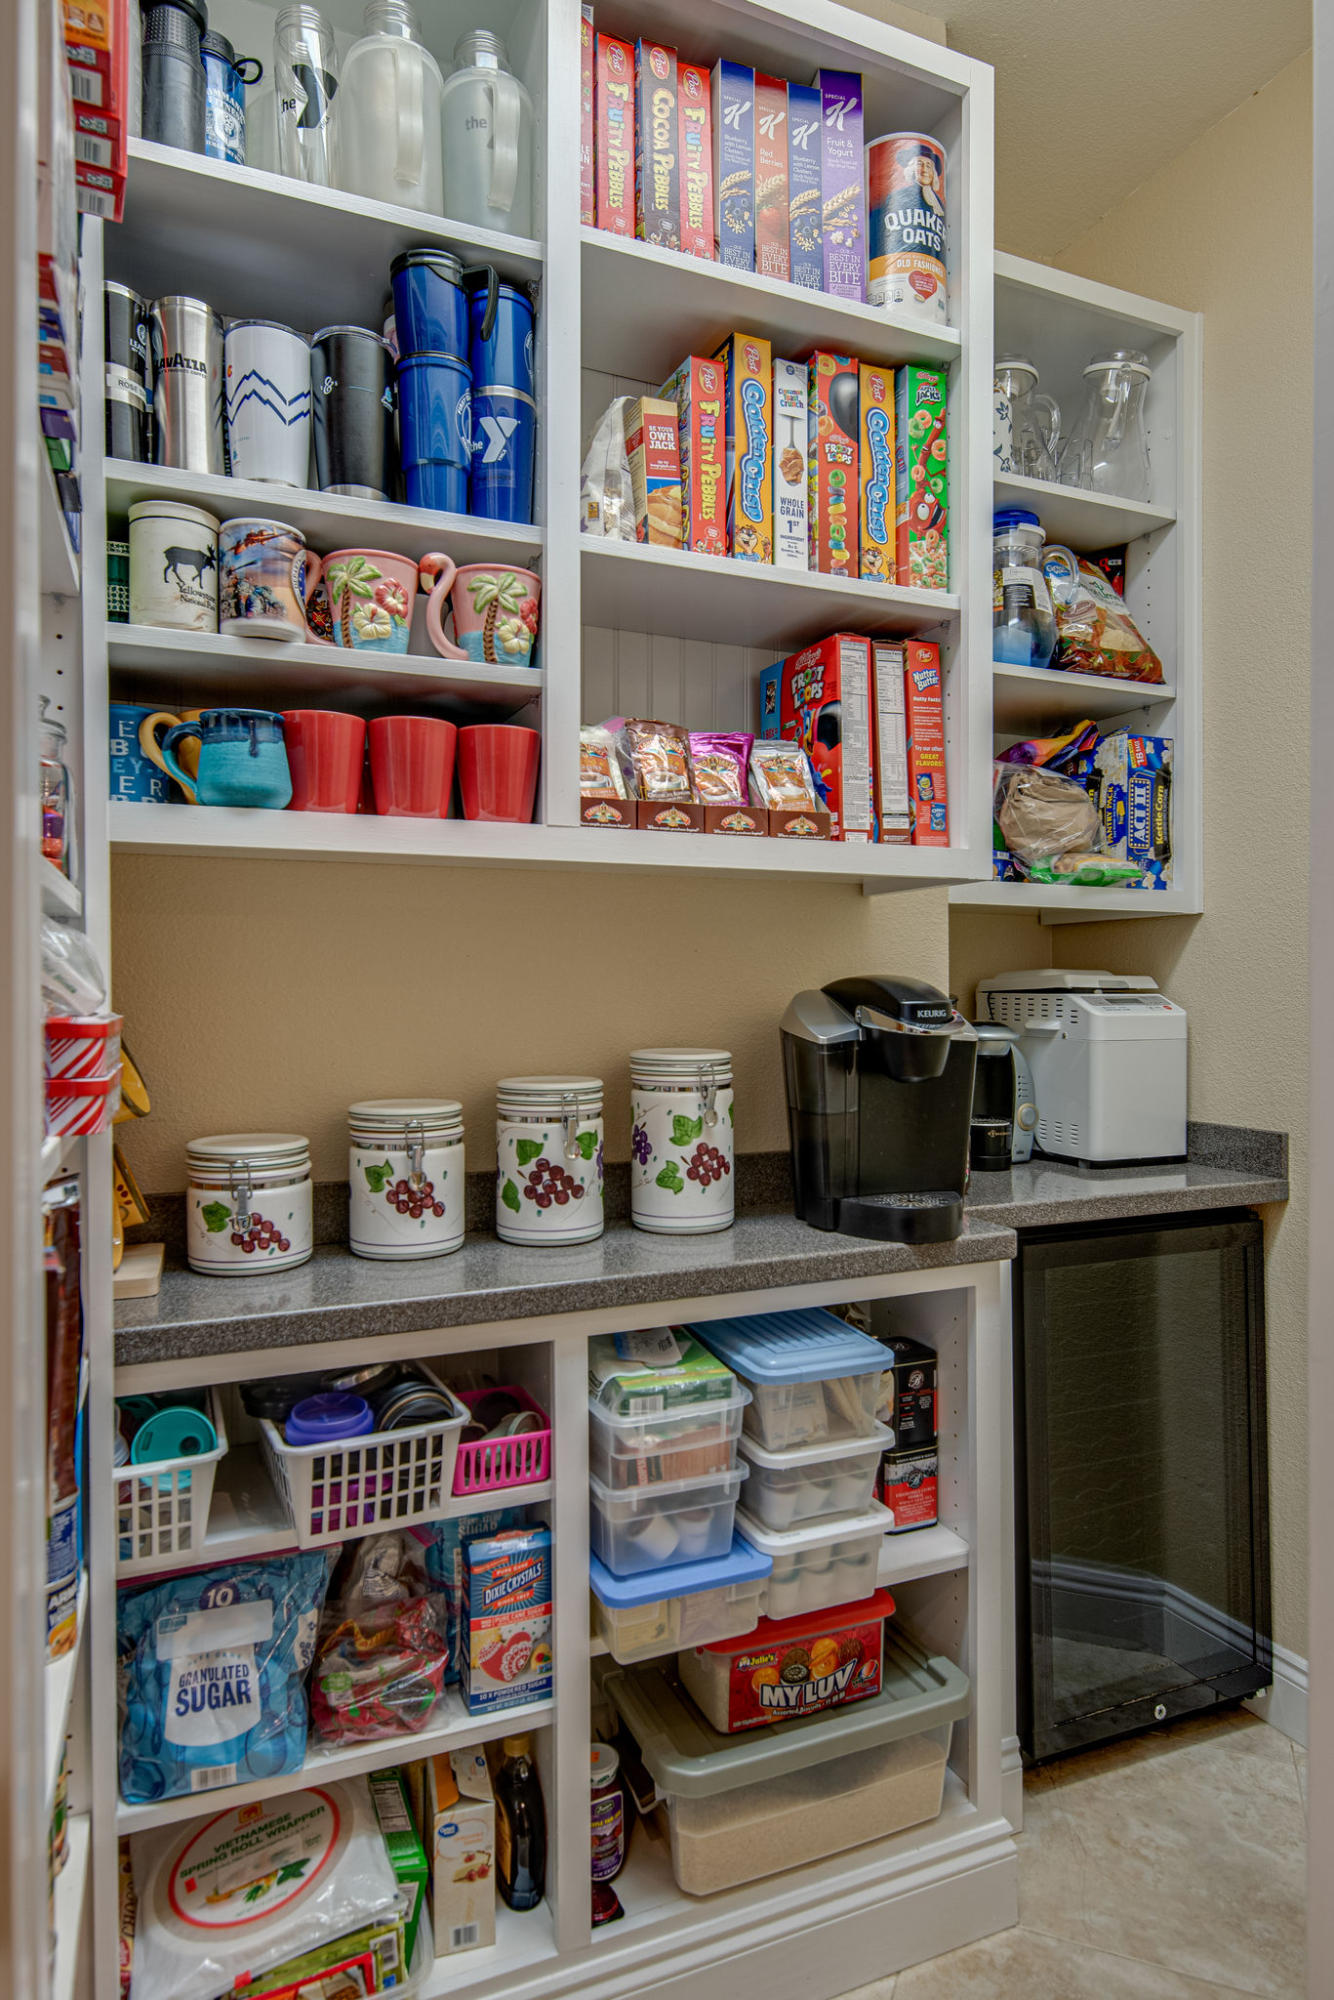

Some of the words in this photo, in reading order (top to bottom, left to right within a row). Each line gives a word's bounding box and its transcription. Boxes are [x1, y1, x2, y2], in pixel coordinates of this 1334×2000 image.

[609, 44, 623, 72] Post
[652, 50, 667, 76] Post
[686, 72, 699, 97] Post
[824, 93, 846, 101] SPECIAL
[464, 115, 488, 131] the
[652, 87, 675, 150] COCOA
[723, 100, 752, 130] K
[825, 97, 858, 132] K
[759, 111, 785, 141] K
[791, 121, 819, 151] K
[826, 136, 845, 148] Fruit
[846, 139, 854, 149] &
[759, 148, 773, 158] Red
[827, 147, 854, 158] Yogurt
[759, 157, 784, 169] Berries
[902, 227, 941, 252] OATS
[761, 244, 778, 254] BEST
[780, 247, 788, 257] IN
[761, 251, 788, 264] EVERY
[828, 252, 850, 263] BEST
[851, 254, 861, 264] IN
[761, 261, 788, 275] BITE
[793, 264, 810, 275] BEST
[829, 261, 861, 273] EVERY
[896, 259, 911, 269] OLD
[793, 271, 820, 284] EVERY
[828, 269, 861, 285] BITE
[747, 344, 759, 375] Post
[872, 374, 884, 403] Post
[780, 400, 804, 409] Crunch
[915, 389, 942, 408] JACKS
[649, 431, 675, 442] OWN
[649, 440, 677, 451] JACK
[826, 453, 853, 465] LOOPS
[780, 496, 805, 510] WHOLE
[780, 505, 805, 519] GRAIN
[791, 665, 825, 697] FROOT
[912, 669, 937, 682] Nutter
[917, 676, 939, 692] Butter
[793, 681, 825, 710] LOOPS
[1135, 753, 1145, 766] 18
[1106, 784, 1114, 808] PACK
[1134, 786, 1147, 805] II
[1156, 785, 1165, 810] Corn
[1106, 811, 1114, 844] PANTRY
[1134, 806, 1146, 842] ACT
[1155, 811, 1164, 845] Kettle
[916, 1008, 947, 1019] KEURIG
[485, 1580, 507, 1605] DIXIE
[505, 1562, 542, 1593] CRYSTALS
[206, 1586, 234, 1609] 10
[750, 1653, 775, 1666] Julie's
[178, 1663, 250, 1688] GRANULATED
[761, 1684, 803, 1708] MY
[803, 1658, 858, 1705] LUV
[175, 1678, 252, 1717] SUGAR
[772, 1706, 799, 1717] Assorted
[800, 1702, 823, 1714] Biscuits
[213, 1812, 292, 1853] VIETNAMESE
[179, 1852, 228, 1879] SPRING
[230, 1837, 264, 1857] ROLL
[265, 1805, 326, 1839] WRAPPER
